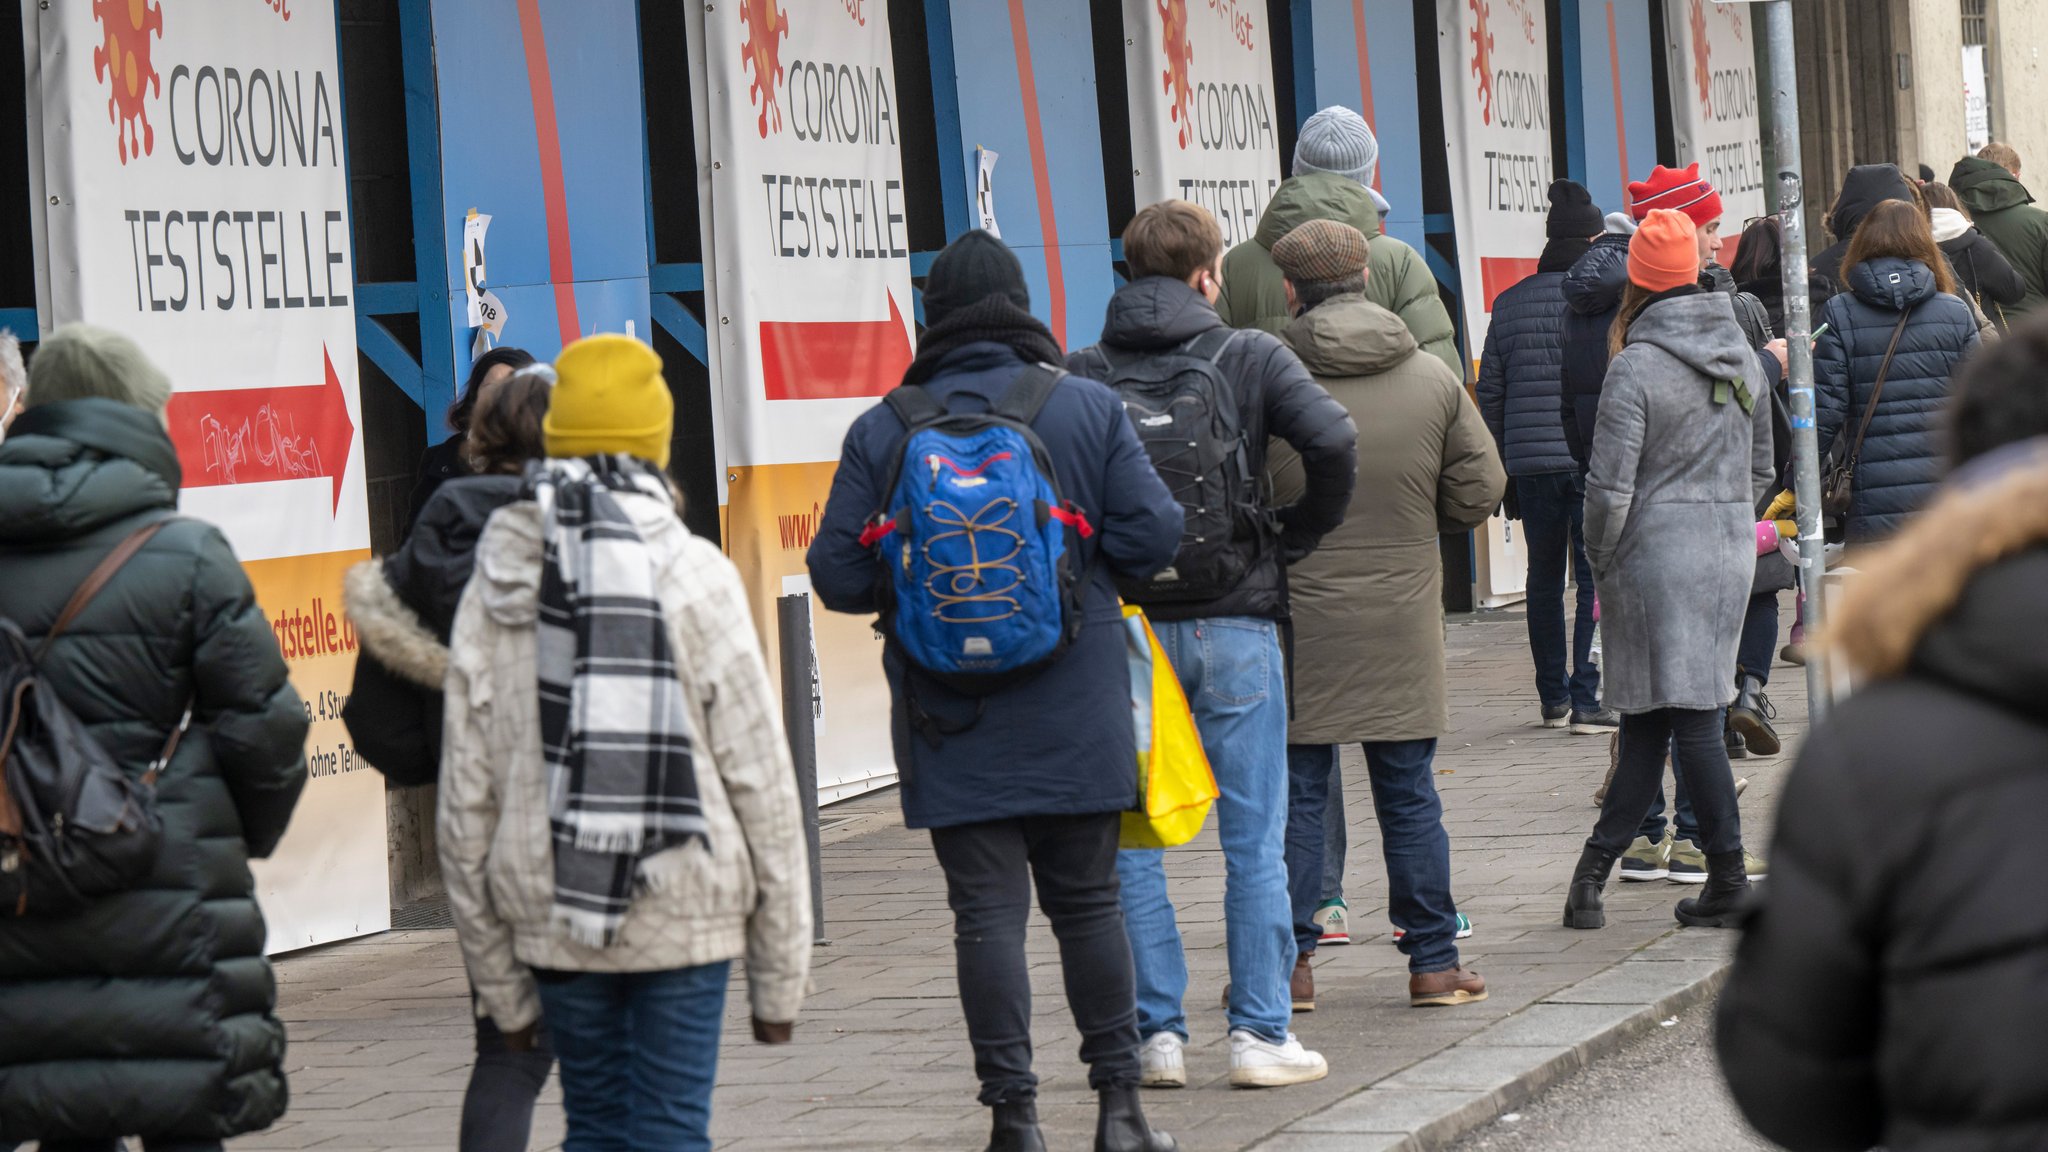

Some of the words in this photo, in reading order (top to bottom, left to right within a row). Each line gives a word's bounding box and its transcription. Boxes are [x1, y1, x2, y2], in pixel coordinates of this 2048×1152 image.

[169, 64, 338, 167] CORONA
[788, 59, 896, 145] CORONA
[1197, 82, 1275, 151] CORONA
[1713, 66, 1757, 122] CORONA
[761, 174, 907, 259] TESTSTELLE
[124, 209, 349, 312] TESTSTELLE
[479, 301, 497, 321] 08
[778, 502, 824, 549] www.C
[319, 691, 326, 721] 4
[310, 745, 338, 779] ohne
